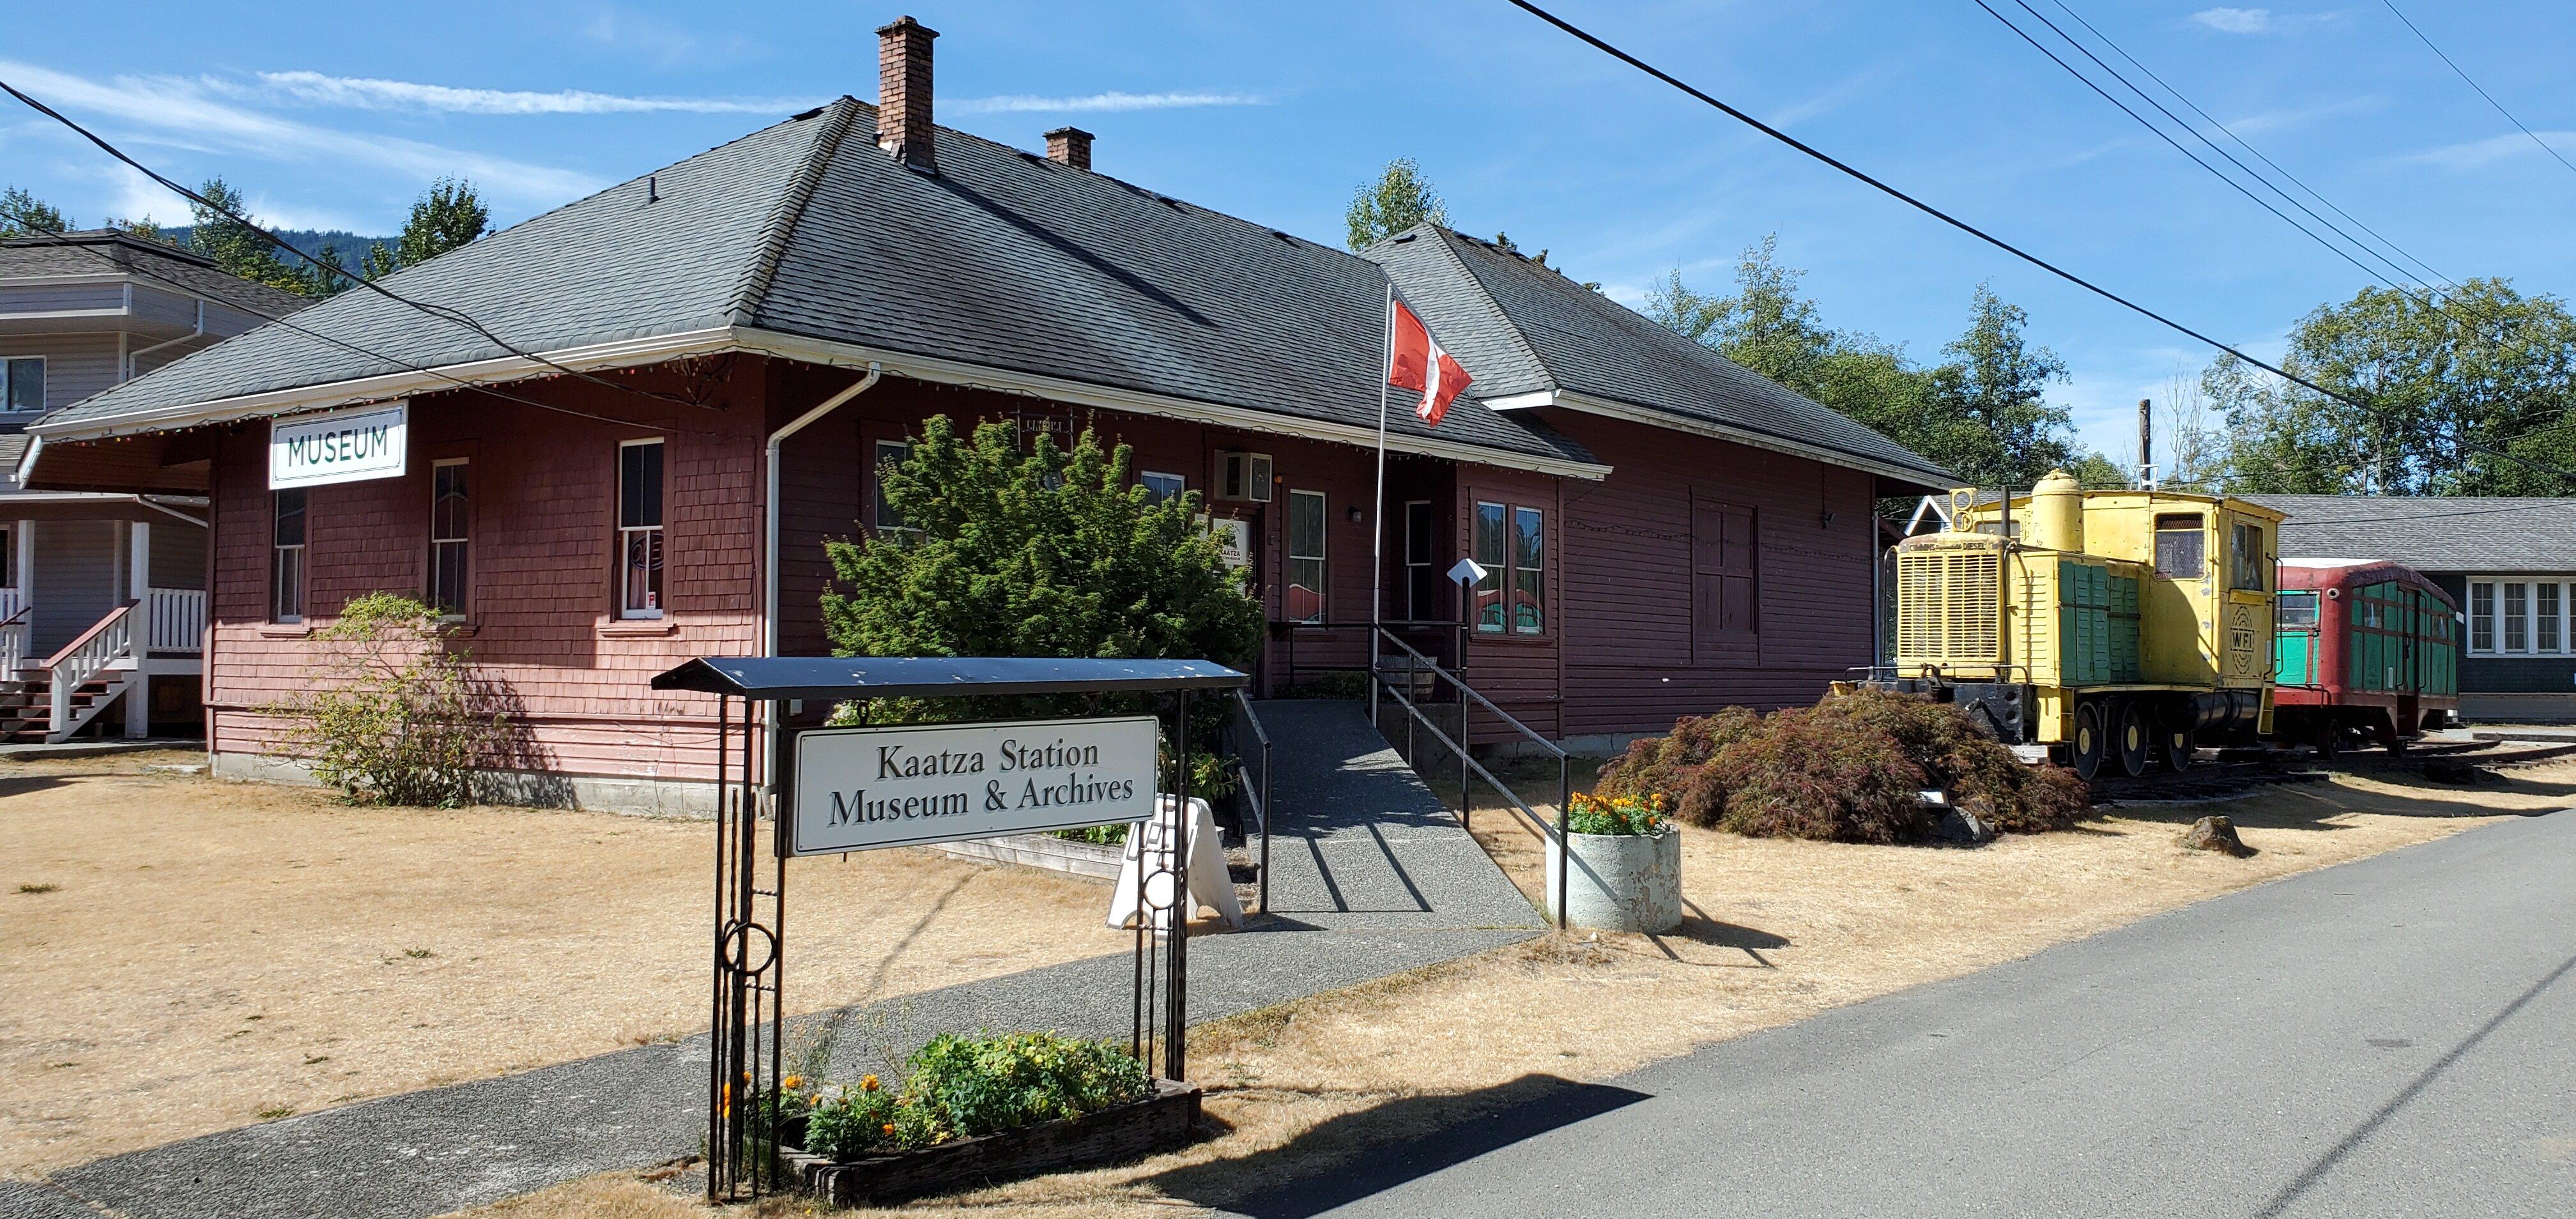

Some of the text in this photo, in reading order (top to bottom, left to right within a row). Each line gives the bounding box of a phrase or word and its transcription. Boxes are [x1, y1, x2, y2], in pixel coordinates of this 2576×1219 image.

[289, 424, 387, 466] MUSEUM
[2233, 632, 2252, 648] WFI
[875, 738, 1100, 779] Kaatza Station
[829, 772, 1133, 825] Museum & Archives
